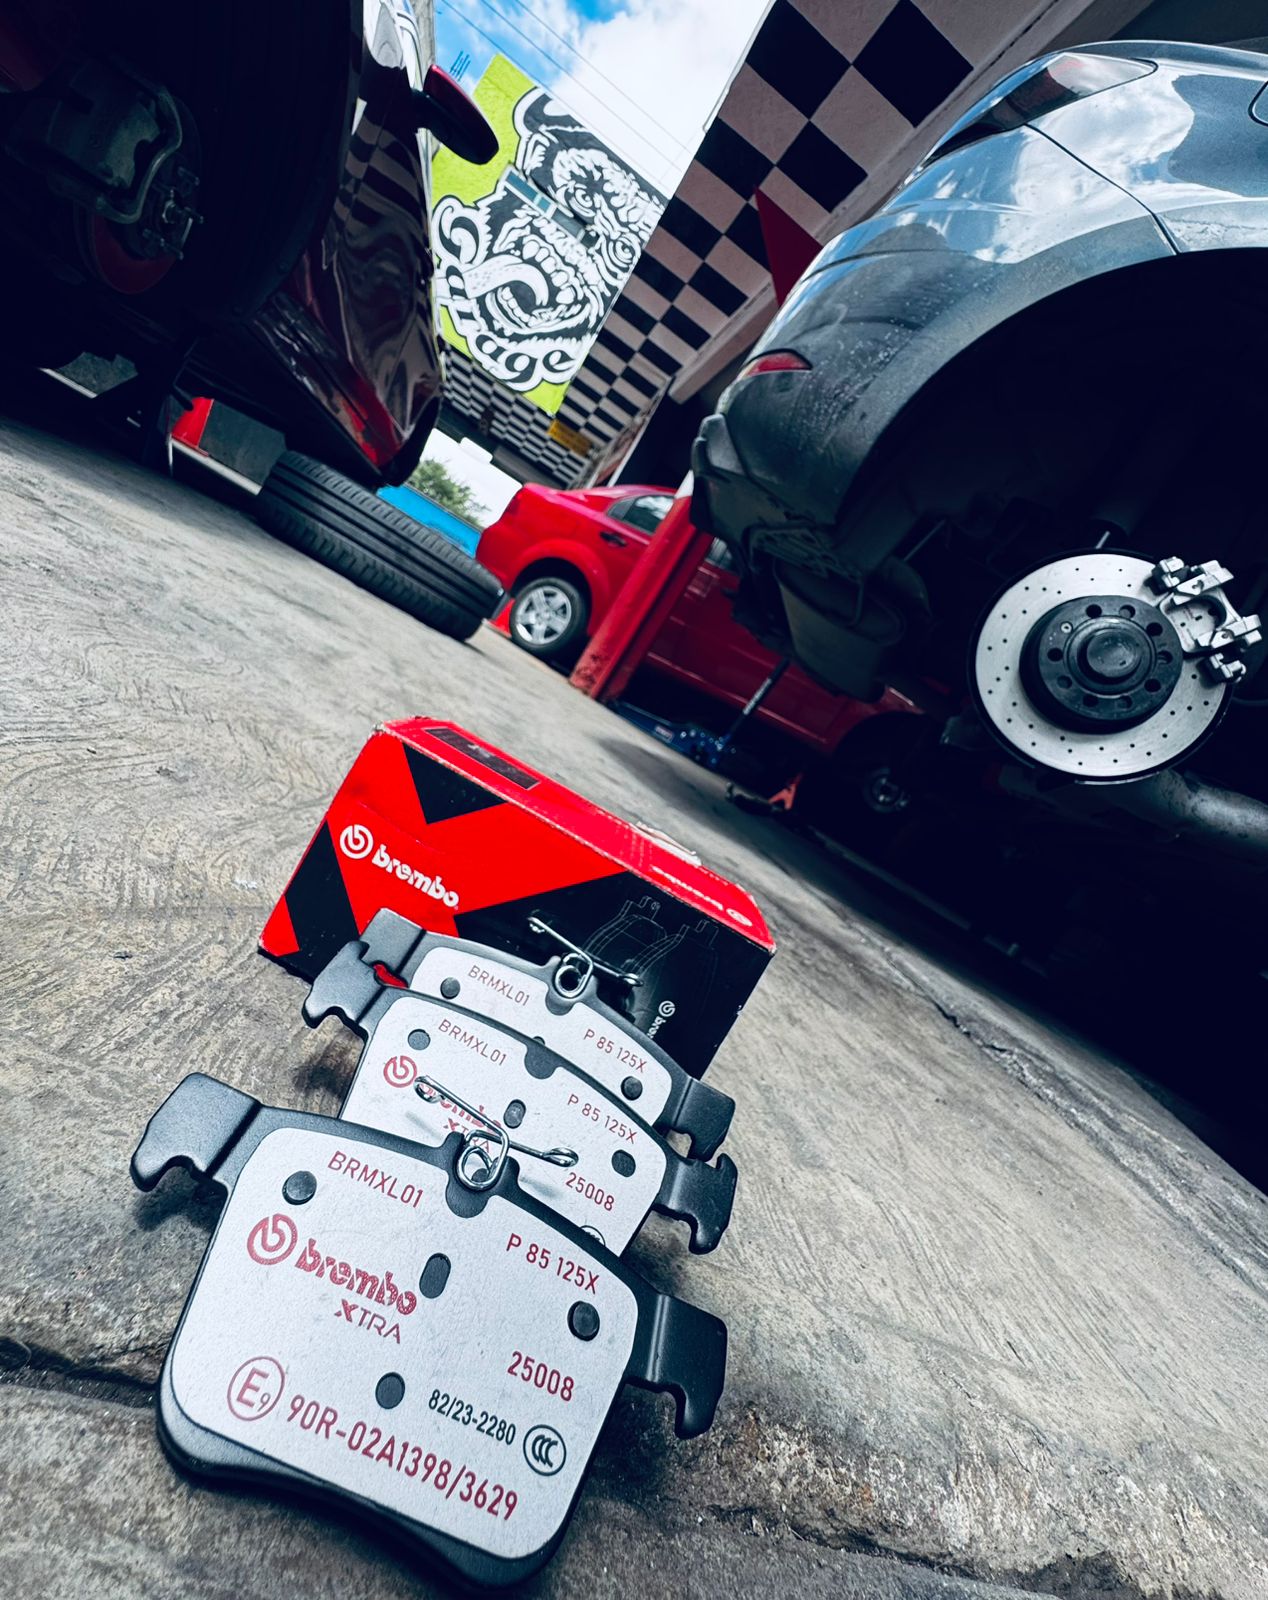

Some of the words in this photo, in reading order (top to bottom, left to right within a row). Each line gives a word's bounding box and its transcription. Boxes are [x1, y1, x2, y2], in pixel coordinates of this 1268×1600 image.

[438, 205, 575, 383] Garage
[372, 844, 459, 908] brembo
[468, 965, 530, 1007] BRMXL01
[438, 1019, 507, 1065] BRMXL01
[584, 1029, 594, 1041] P
[597, 1035, 614, 1052] 85
[617, 1046, 646, 1073] 125X
[568, 1093, 579, 1107] P
[581, 1101, 601, 1120] 85
[605, 1114, 637, 1144] 125X
[328, 1150, 424, 1208] BRMXL01
[565, 1172, 615, 1211] 25008
[294, 1238, 418, 1316] brembo
[506, 1232, 522, 1252] P
[525, 1243, 551, 1269] 85
[556, 1256, 600, 1295] 125X
[334, 1299, 401, 1344] XTRA
[508, 1352, 574, 1402] 25008
[428, 1388, 516, 1445] 82/23-2280
[287, 1394, 519, 1521] 90R-02A1398/3629
